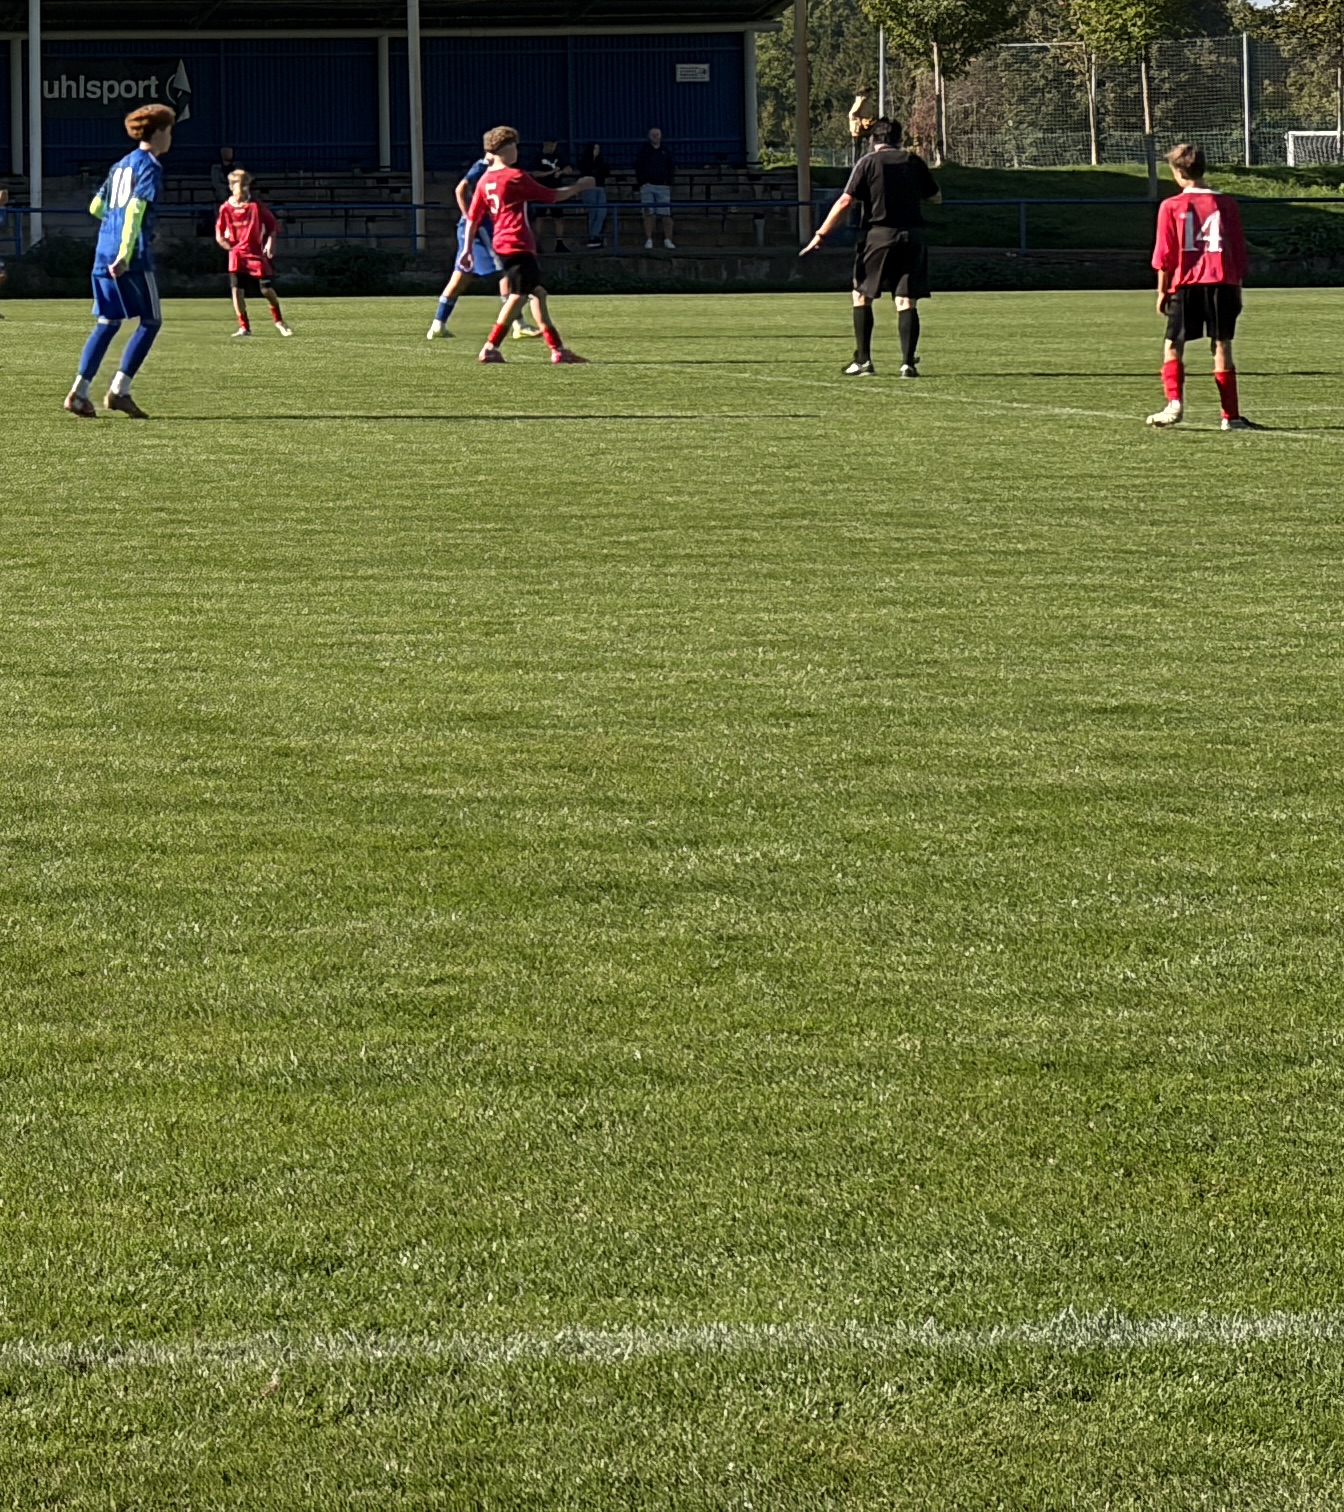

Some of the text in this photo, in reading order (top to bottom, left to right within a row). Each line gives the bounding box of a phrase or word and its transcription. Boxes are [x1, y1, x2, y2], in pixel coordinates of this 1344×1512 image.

[43, 74, 159, 105] uhlsport
[109, 167, 133, 209] 10
[484, 182, 500, 215] 5
[1181, 210, 1223, 253] 14
